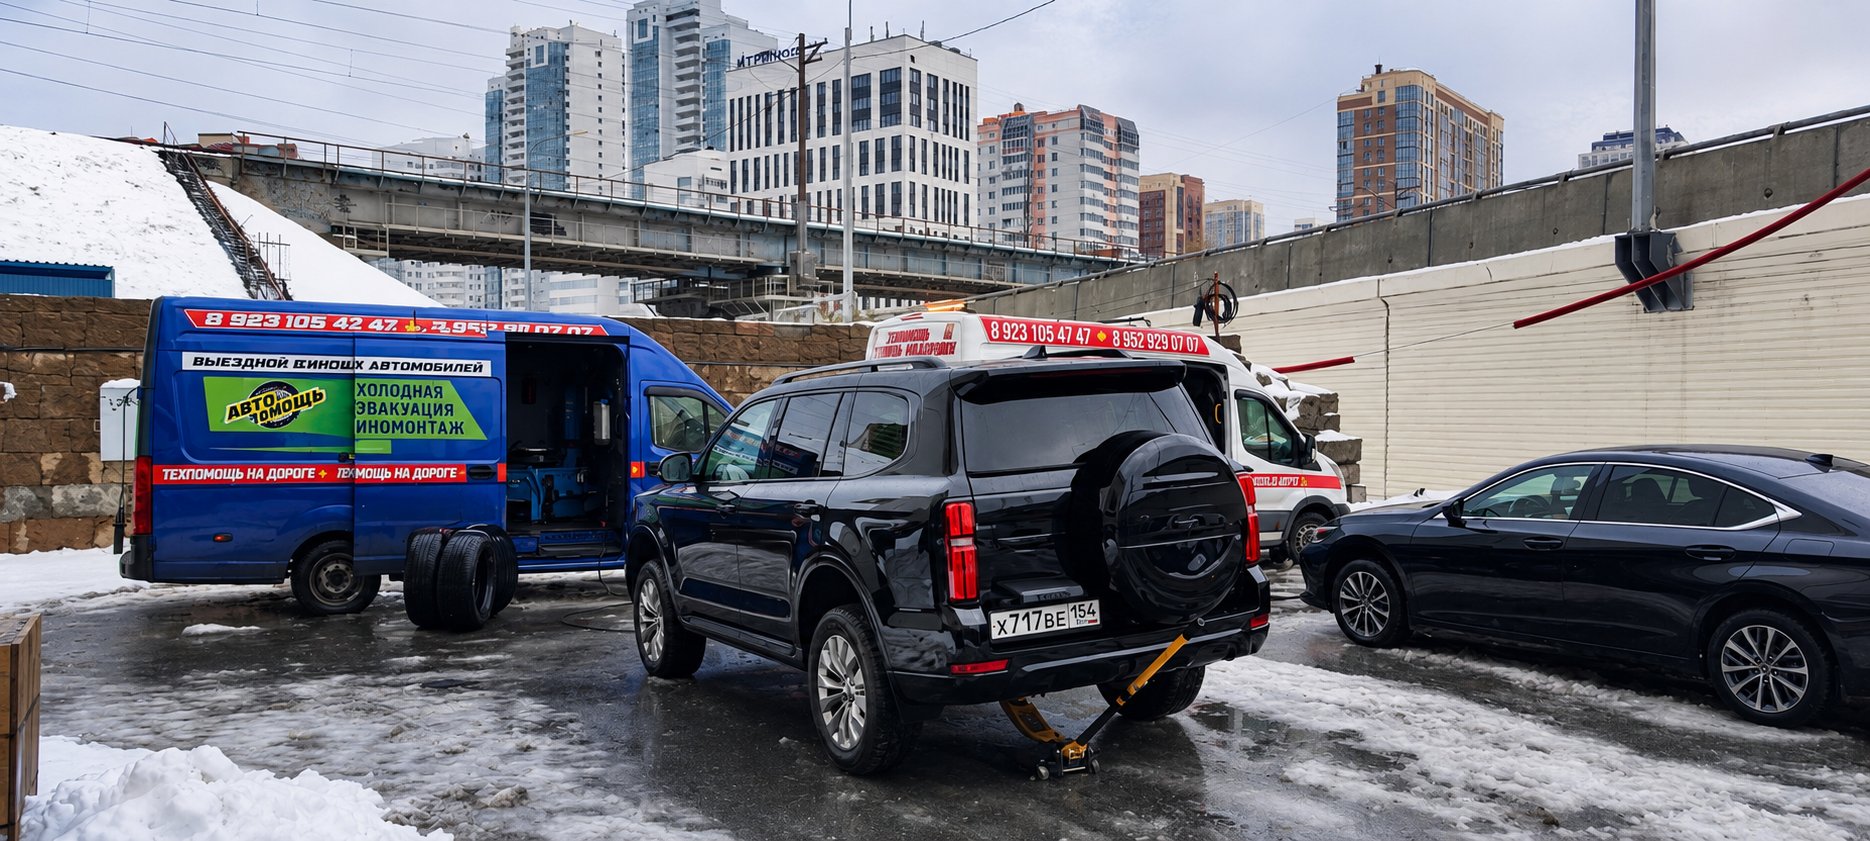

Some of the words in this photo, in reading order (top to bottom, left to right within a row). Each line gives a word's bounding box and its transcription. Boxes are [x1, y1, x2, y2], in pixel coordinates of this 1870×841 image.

[204, 313, 223, 326] 8
[230, 313, 280, 328] 923
[285, 315, 327, 329] 105
[332, 317, 362, 330] 42
[991, 321, 999, 339] 8
[1003, 322, 1028, 341] 923
[1031, 324, 1054, 342] 105
[1057, 326, 1072, 343] 47
[1076, 327, 1091, 344] 47
[1113, 330, 1120, 346] 8
[1123, 331, 1144, 349] 952
[1148, 333, 1168, 350] 929
[1171, 335, 1185, 351] 07
[1187, 337, 1199, 353] 07
[193, 356, 289, 370] ВЫЕЗДНОЙ
[369, 360, 483, 373] АВТОМОБИЛЕЙ
[356, 382, 443, 400] ХОЛОДНАЯ
[227, 394, 276, 421] АВТО
[356, 401, 454, 419] ЭВАКУАЦИЯ
[356, 420, 464, 435] ИНОМОНТАЖ
[162, 468, 244, 482] ТЕХПОМОЩЬ
[246, 468, 263, 480] НА
[266, 468, 316, 481] ДОРОГЕ
[394, 468, 410, 479] НА
[412, 467, 457, 480] ДОРОГЕ
[1070, 603, 1096, 619] 154
